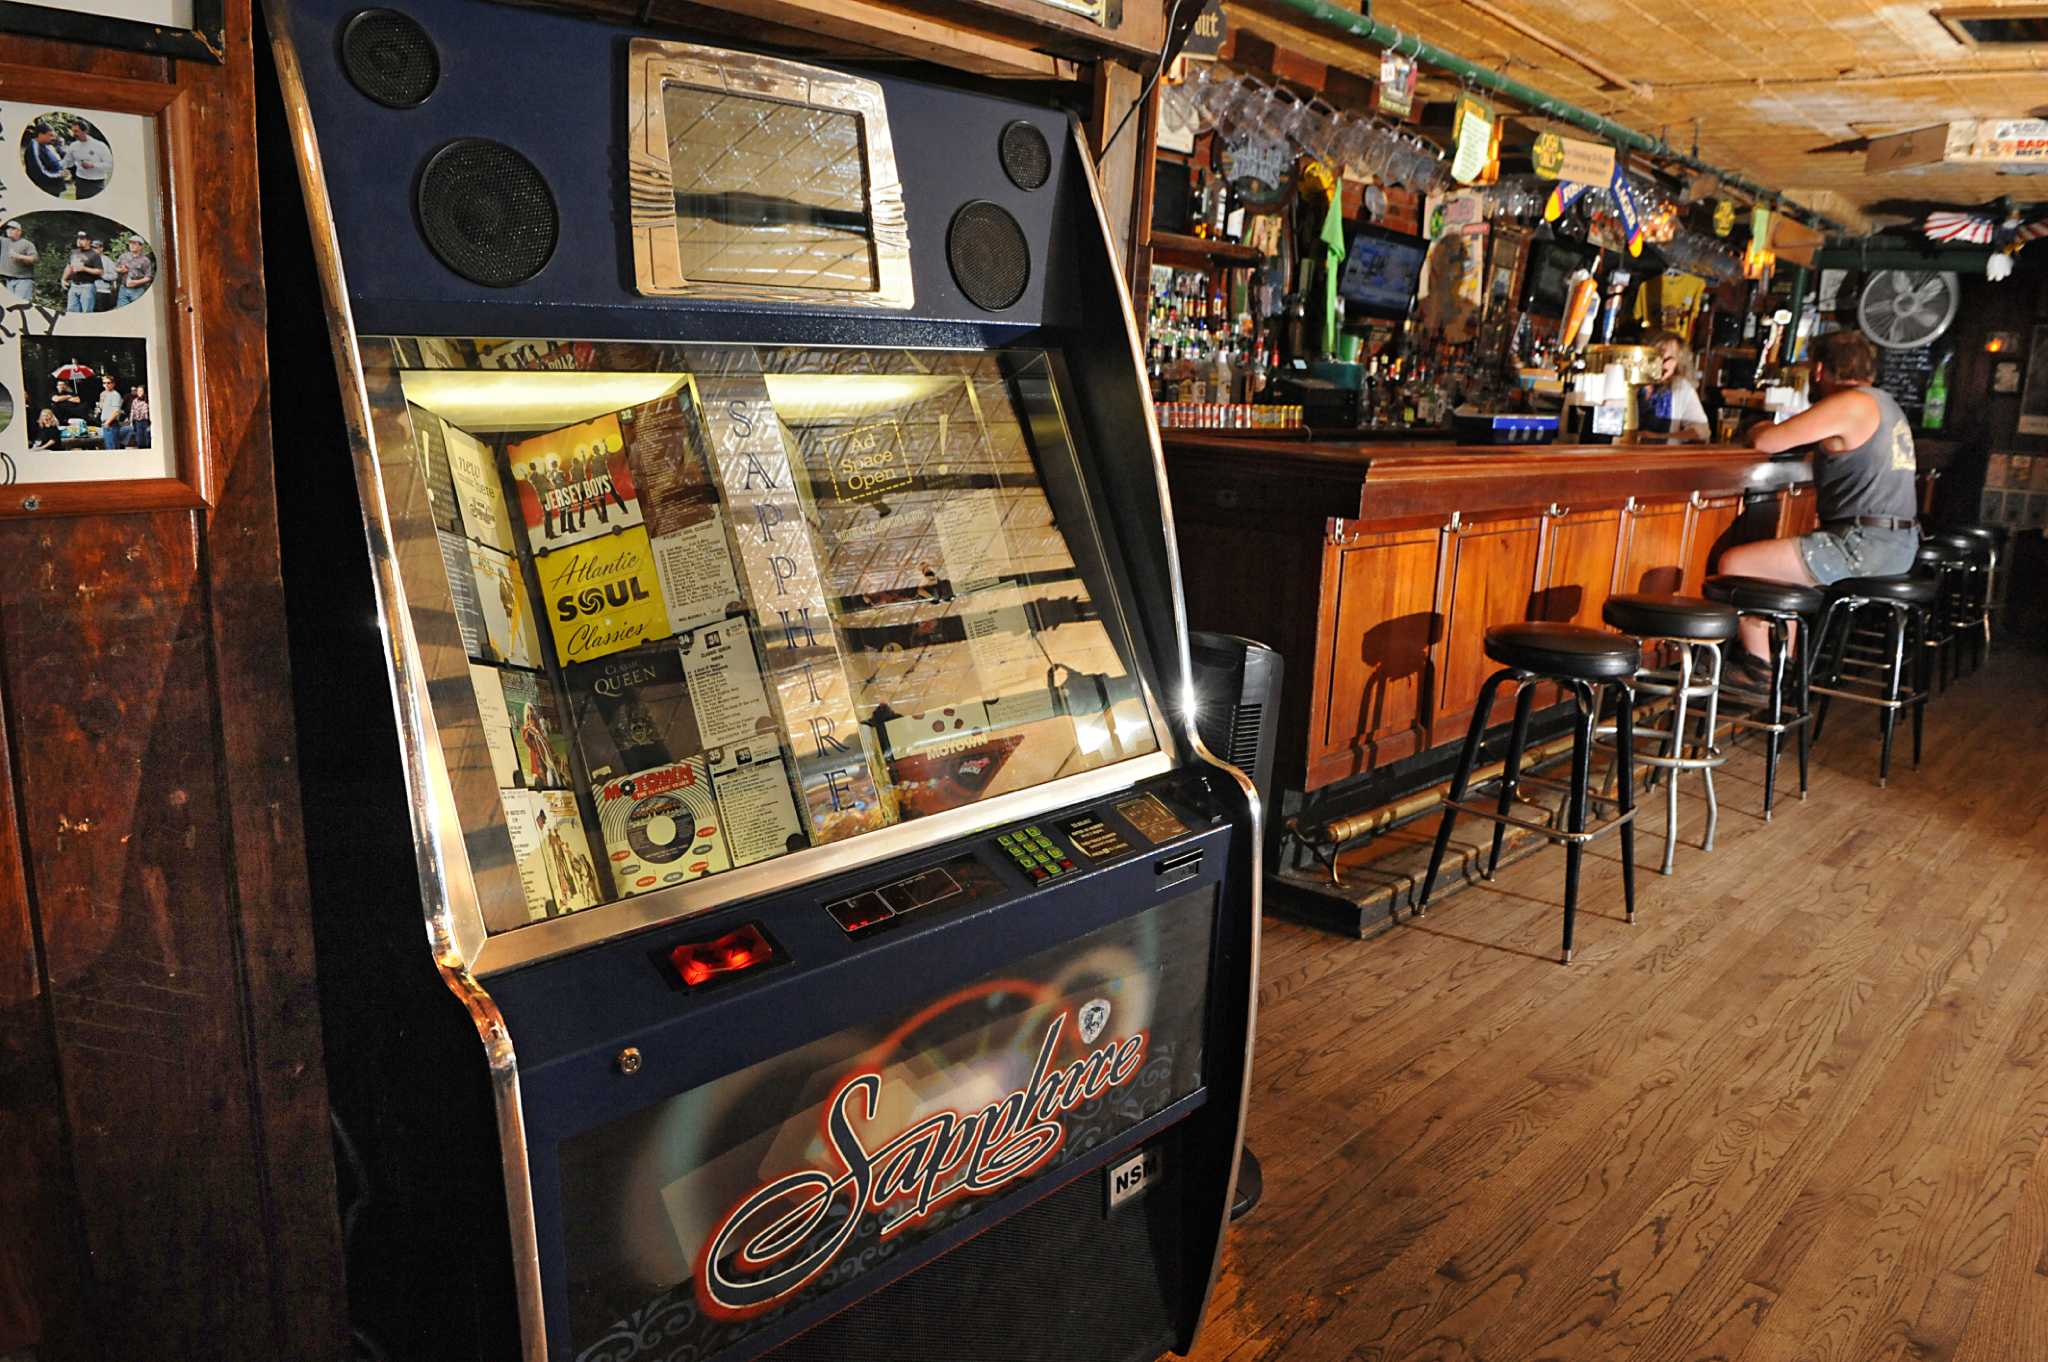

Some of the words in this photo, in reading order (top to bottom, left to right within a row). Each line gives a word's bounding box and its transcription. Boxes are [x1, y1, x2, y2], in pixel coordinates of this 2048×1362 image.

[851, 432, 876, 452] Ad
[841, 448, 895, 475] Space
[544, 482, 584, 512] JERSEY
[583, 474, 612, 499] BOYS
[847, 466, 897, 491] Open
[551, 550, 640, 589] Atlantic
[557, 576, 649, 621] SOUL
[727, 400, 855, 812] SAPPHIRE
[567, 621, 647, 655] Classics
[677, 633, 690, 645] 34
[594, 666, 657, 697] QUEEN
[708, 749, 721, 760] 35
[926, 732, 989, 761] MOTOWN
[704, 1010, 1144, 1311] Sapphire
[1115, 1156, 1158, 1194] NSM
